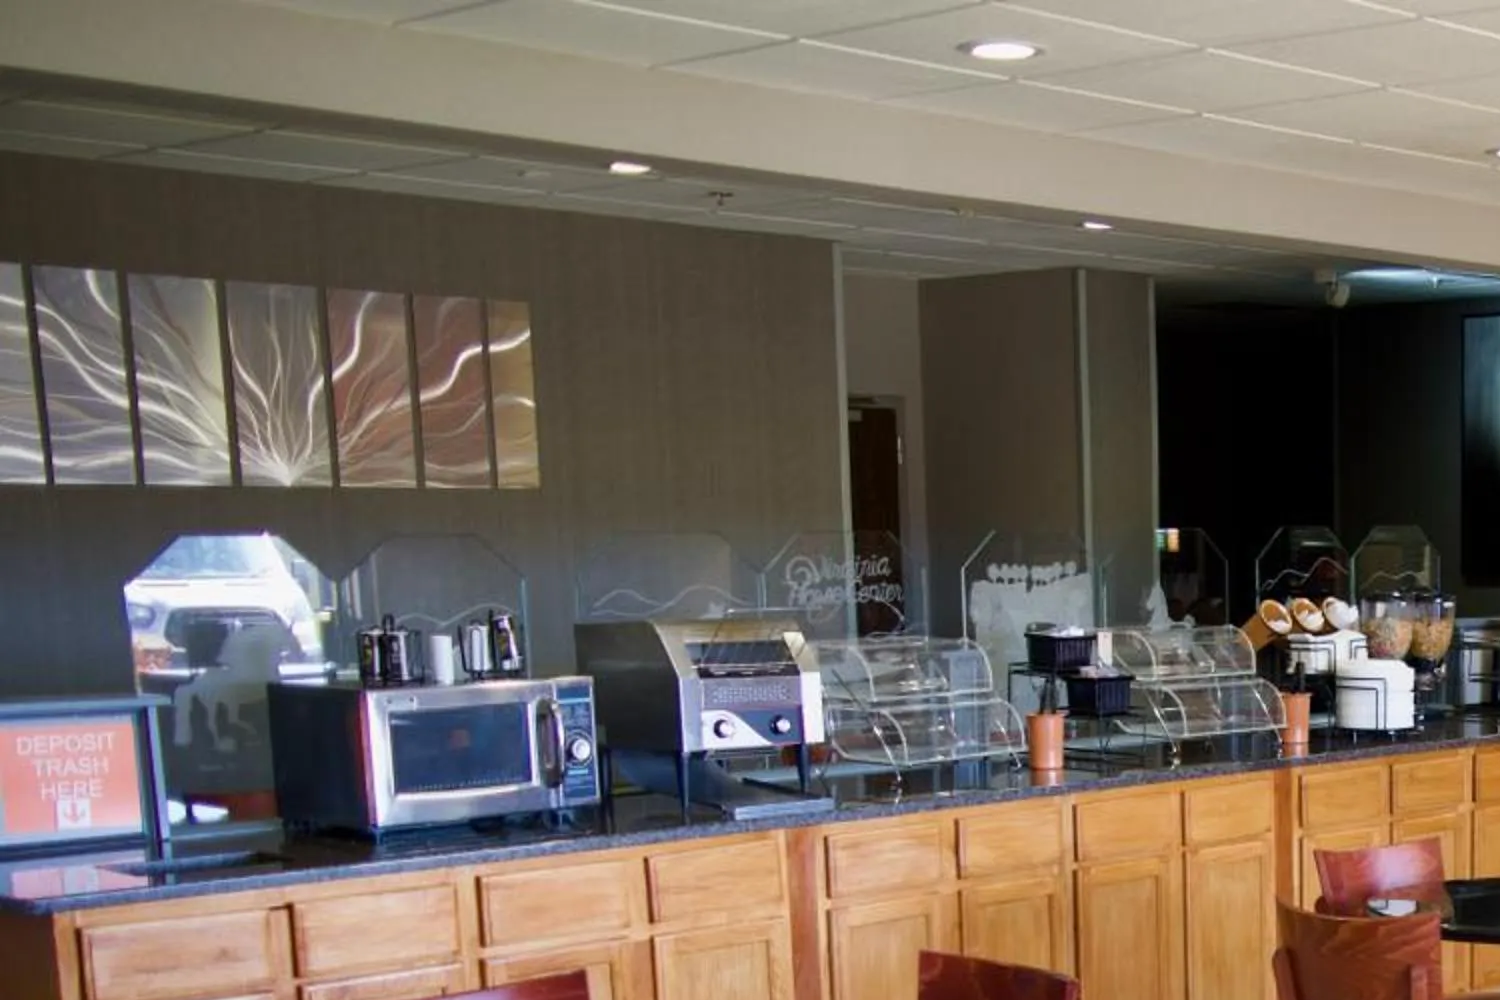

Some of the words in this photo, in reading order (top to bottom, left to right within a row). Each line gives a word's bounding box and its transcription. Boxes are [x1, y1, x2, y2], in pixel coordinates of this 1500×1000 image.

[15, 730, 117, 756] DEPOSIT
[31, 756, 110, 778] TRASH
[41, 779, 104, 801] HERE
